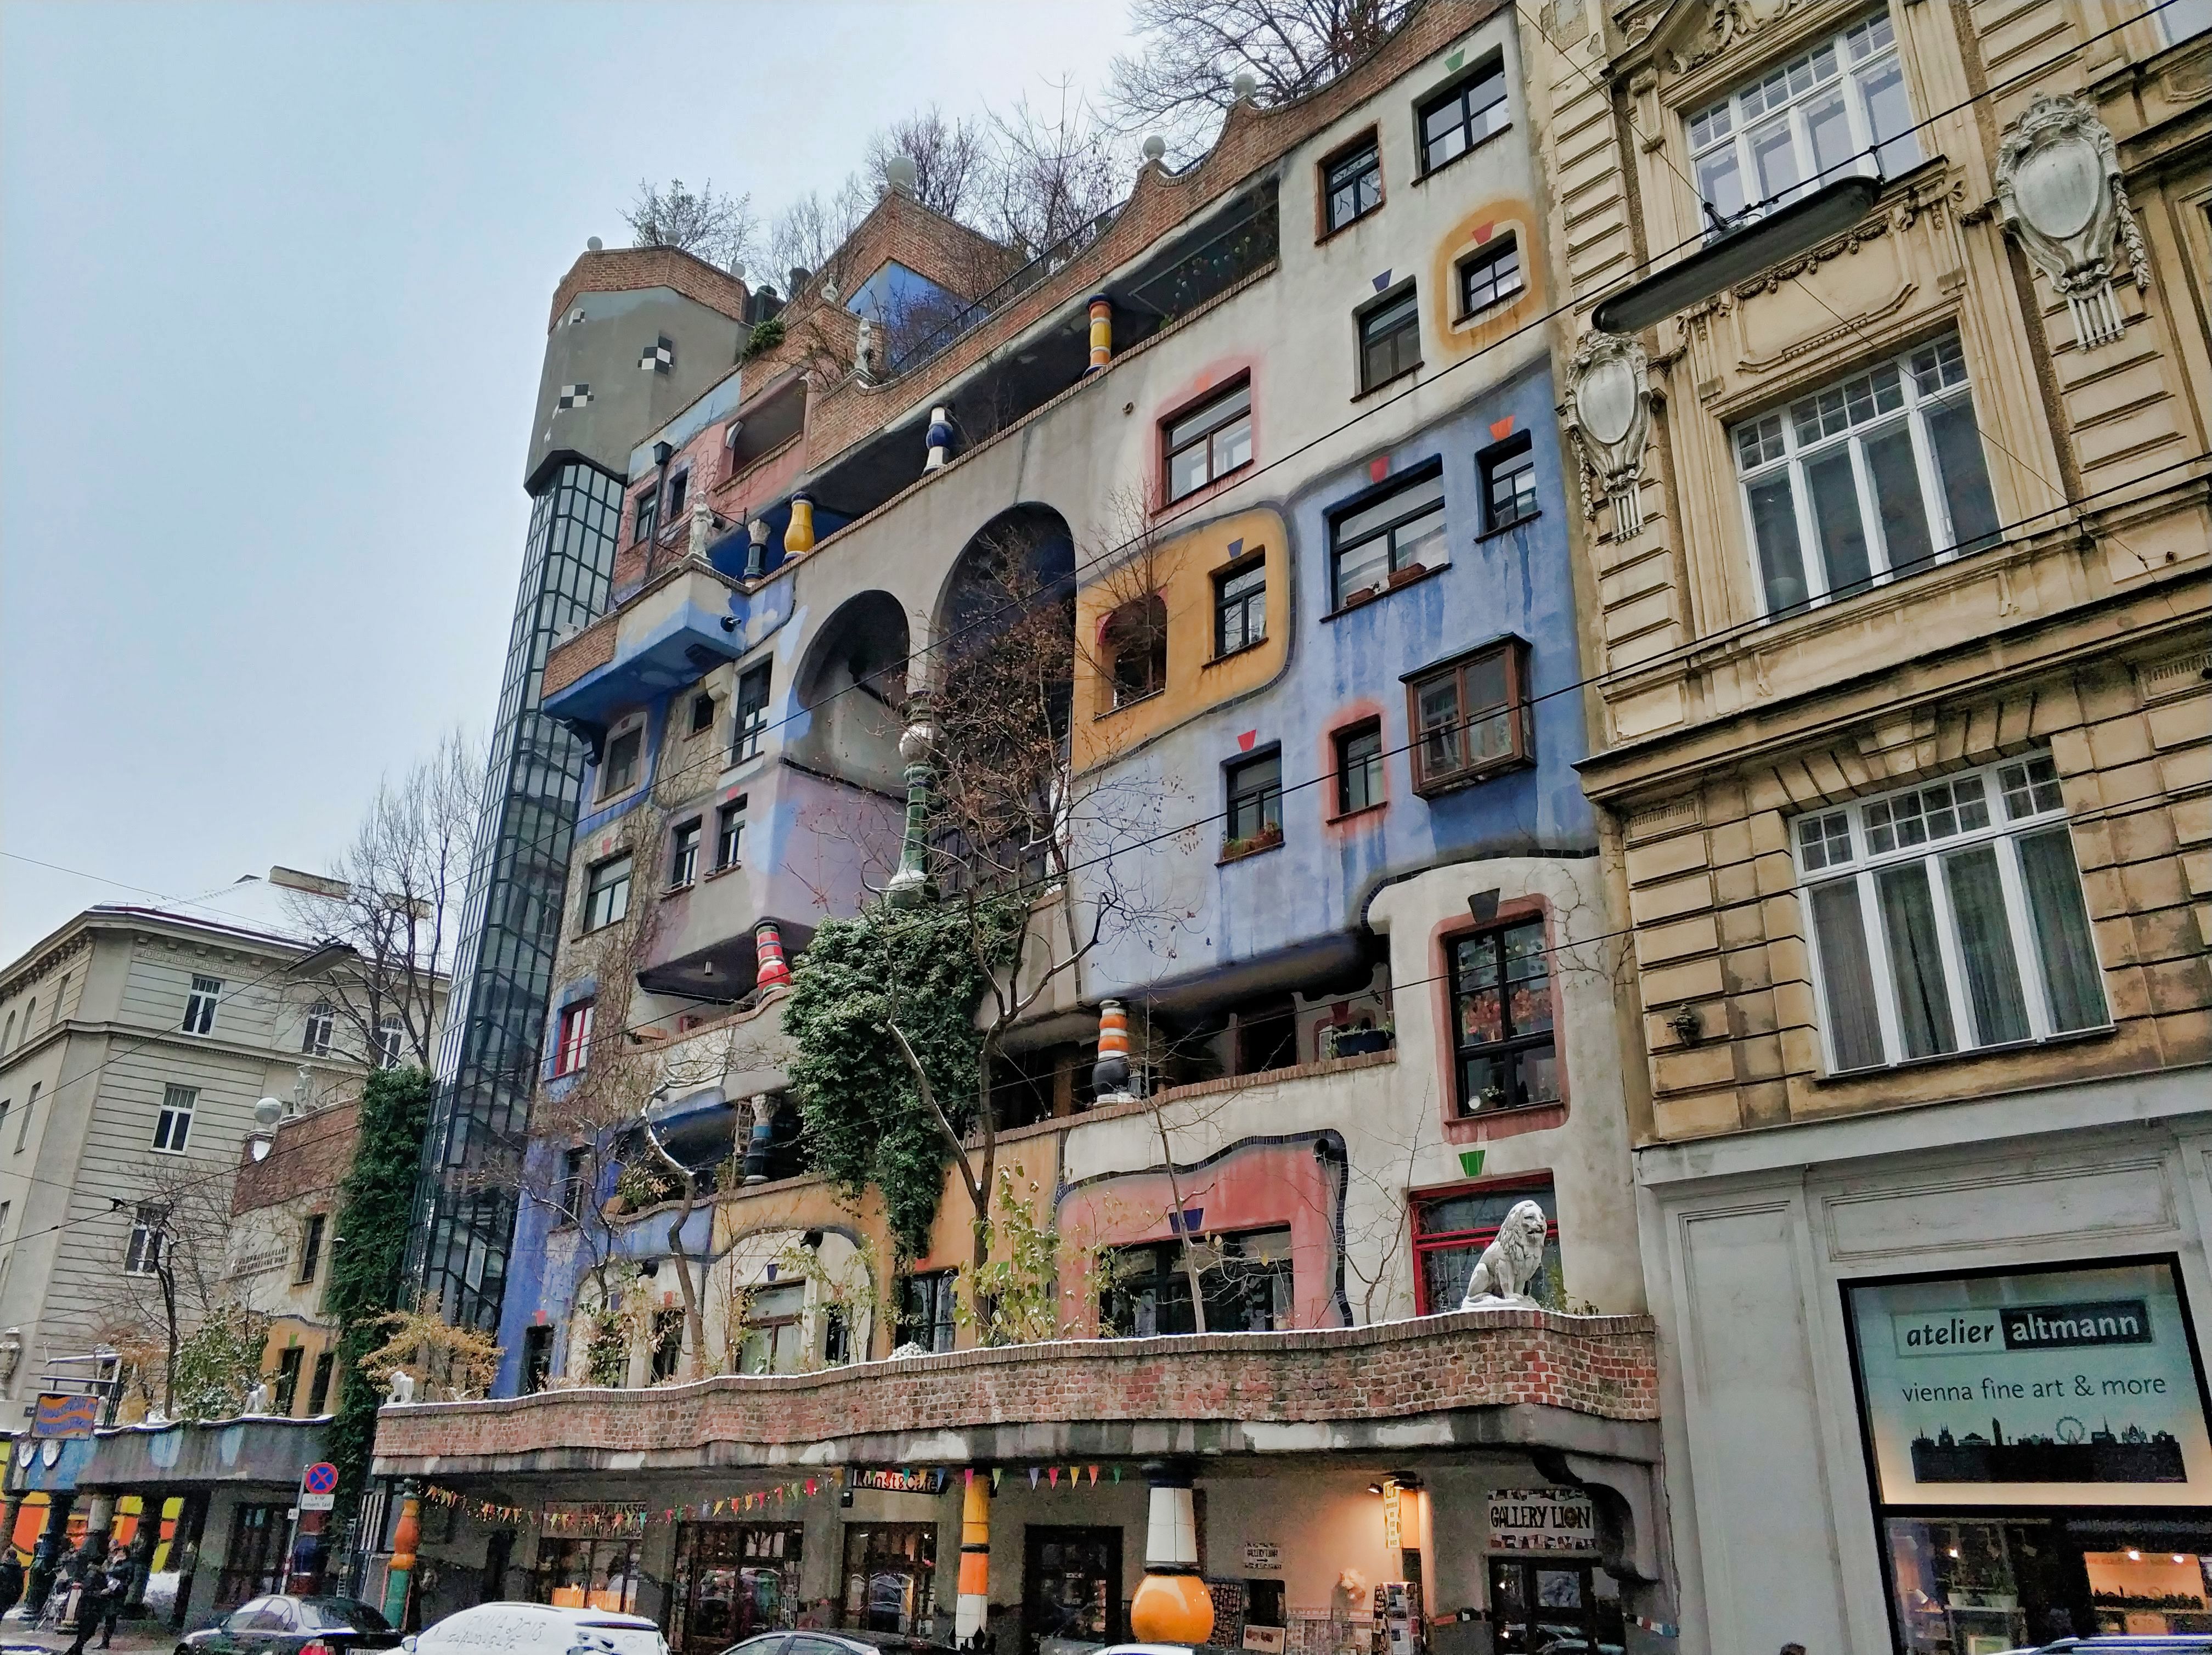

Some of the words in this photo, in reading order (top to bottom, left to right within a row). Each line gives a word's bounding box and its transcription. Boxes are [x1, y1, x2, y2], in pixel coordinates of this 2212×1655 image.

[1906, 1318, 1994, 1347] atelier
[2011, 1313, 2140, 1342] altmann
[1901, 1382, 1973, 1402] vienna
[1980, 1377, 2024, 1399] fine
[2032, 1379, 2065, 1398] art
[2074, 1375, 2095, 1397] &
[2102, 1378, 2166, 1395] more
[1491, 1506, 1548, 1528] GALLERY
[1550, 1506, 1590, 1529] LION
